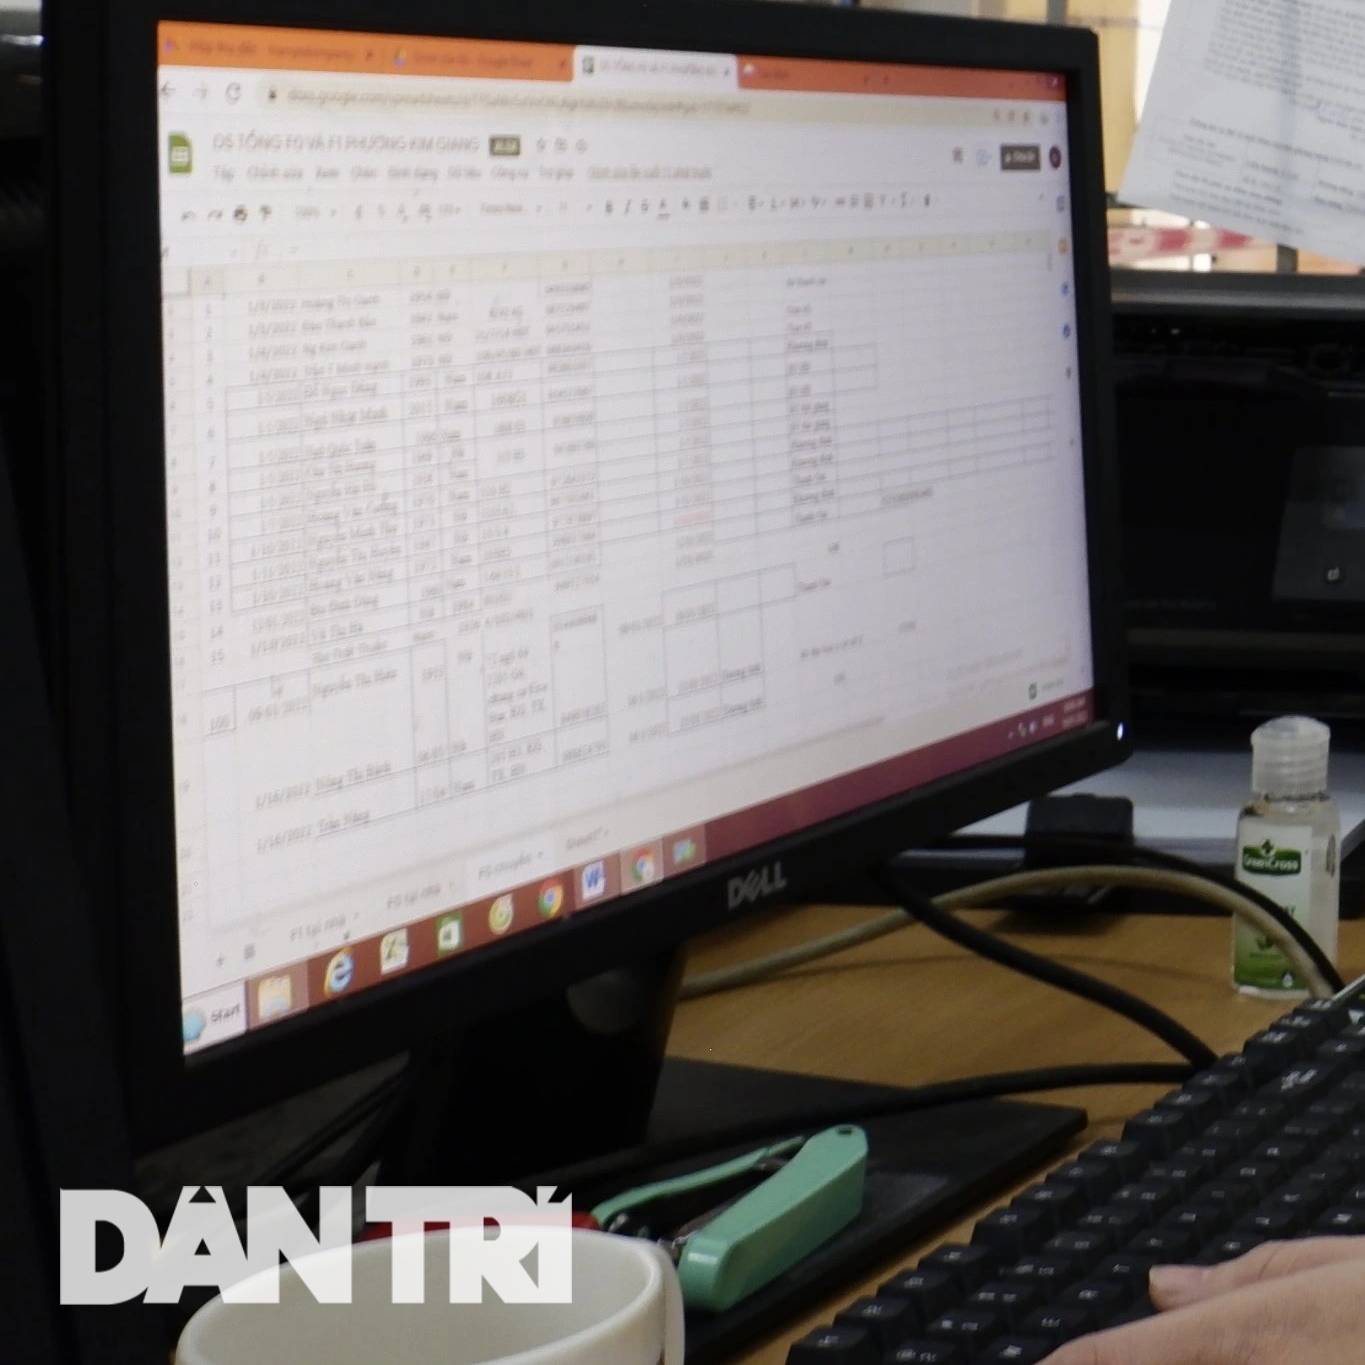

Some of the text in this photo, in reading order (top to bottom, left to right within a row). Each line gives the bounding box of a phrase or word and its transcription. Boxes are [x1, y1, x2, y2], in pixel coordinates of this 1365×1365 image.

[1244, 853, 1298, 872] GreenCross
[728, 861, 787, 910] DELL
[210, 1002, 242, 1023] Start
